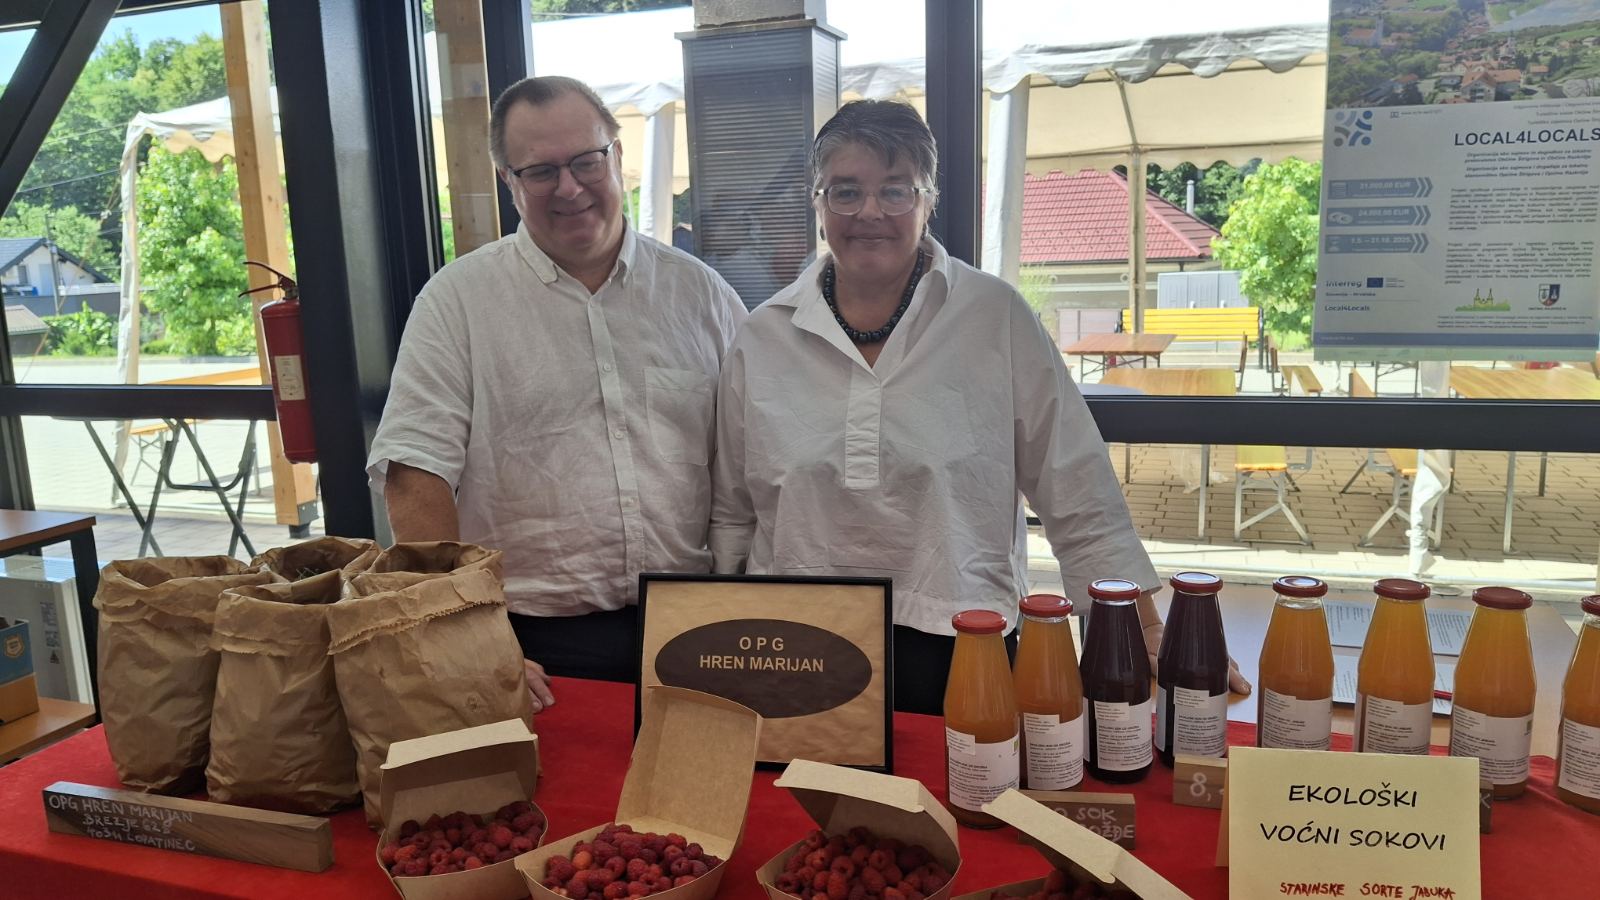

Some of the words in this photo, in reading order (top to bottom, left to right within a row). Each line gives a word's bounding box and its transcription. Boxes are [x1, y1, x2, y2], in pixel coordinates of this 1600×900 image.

[1454, 127, 1600, 146] LOCAL4LOCALS
[699, 654, 744, 670] HREN
[749, 656, 824, 672] MARIJAN
[1288, 782, 1417, 808] EKOLOŠKI
[48, 795, 78, 812] OPG
[81, 799, 124, 815] HREN
[129, 804, 193, 824] MARIJAN
[1076, 807, 1116, 821] SOK
[1260, 821, 1340, 845] VOĆNI
[1349, 829, 1446, 851] SOKOVI
[1279, 882, 1345, 897] STARINSKE
[1359, 882, 1403, 898] SORTE
[1408, 884, 1456, 900] JABUKA
